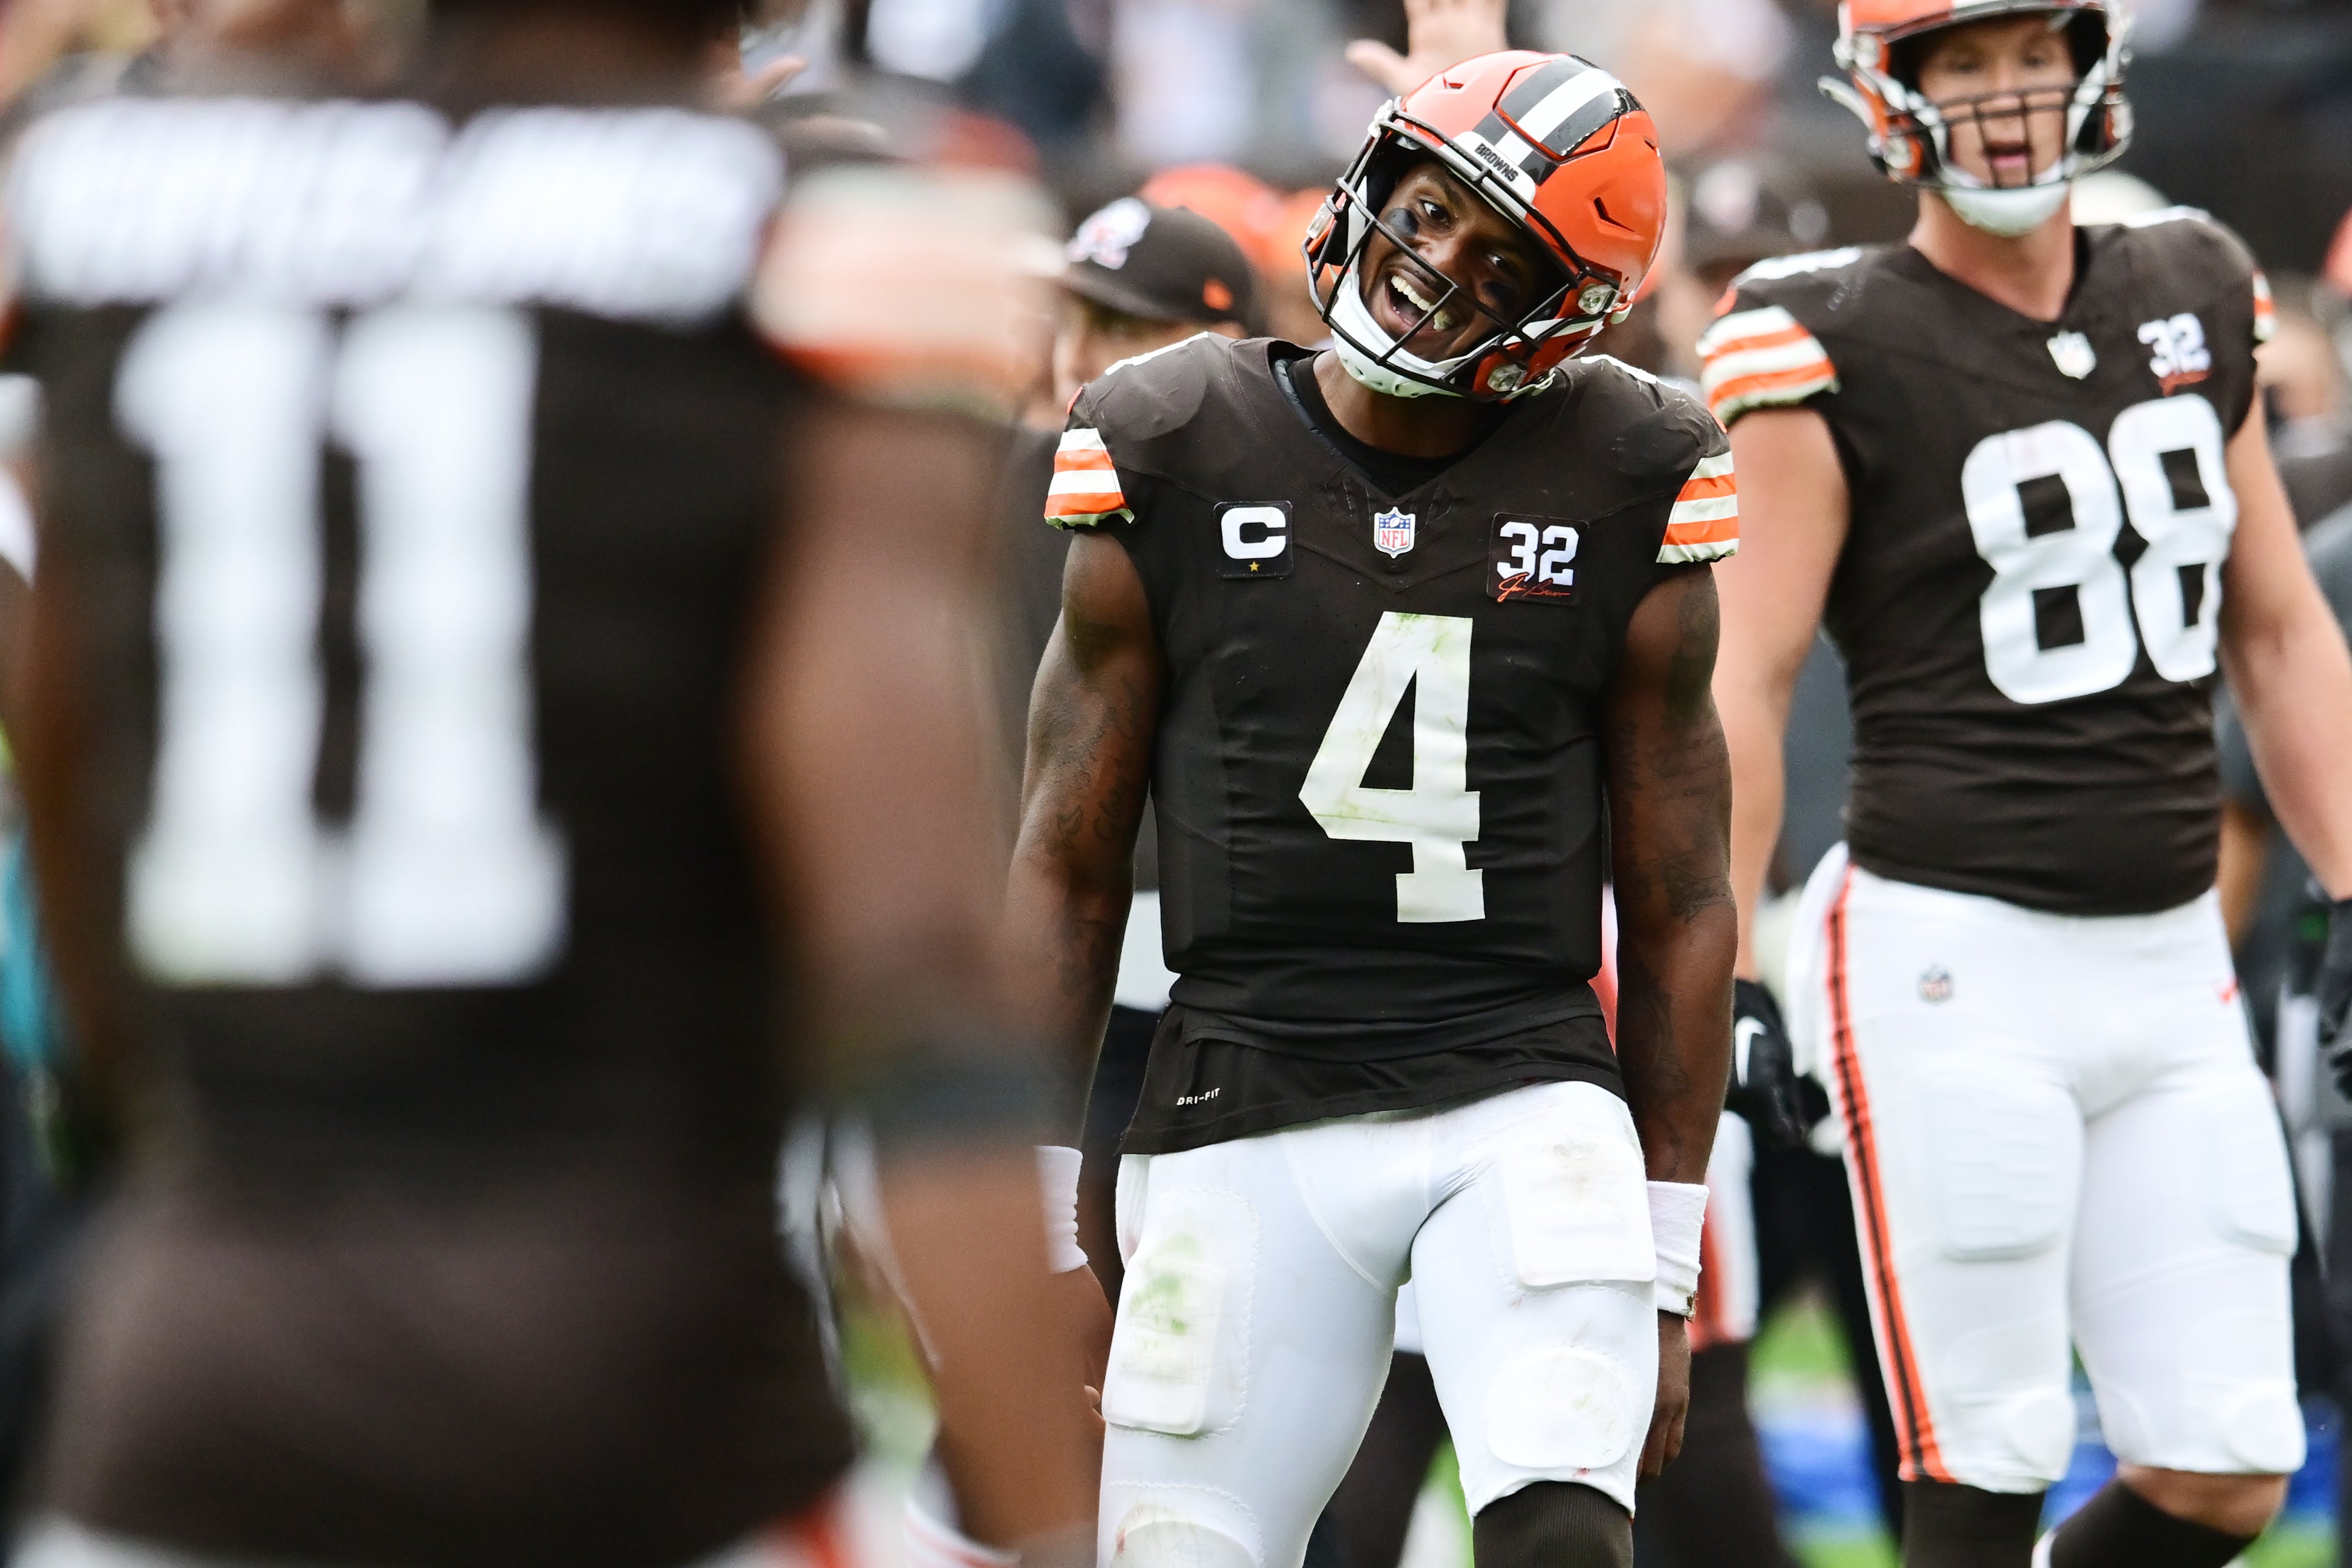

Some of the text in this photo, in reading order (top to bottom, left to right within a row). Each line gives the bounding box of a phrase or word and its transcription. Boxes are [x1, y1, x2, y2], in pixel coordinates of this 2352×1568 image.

[1474, 143, 1519, 182] BROWNS
[2137, 312, 2212, 379] 32
[1221, 507, 1286, 560] C
[1381, 530, 1407, 548] NFL
[1497, 521, 1579, 586] 32
[1960, 393, 2238, 705] 88
[114, 295, 566, 988] 11
[1298, 611, 1485, 923] 4
[1176, 1087, 1220, 1106] DRI-FIT
